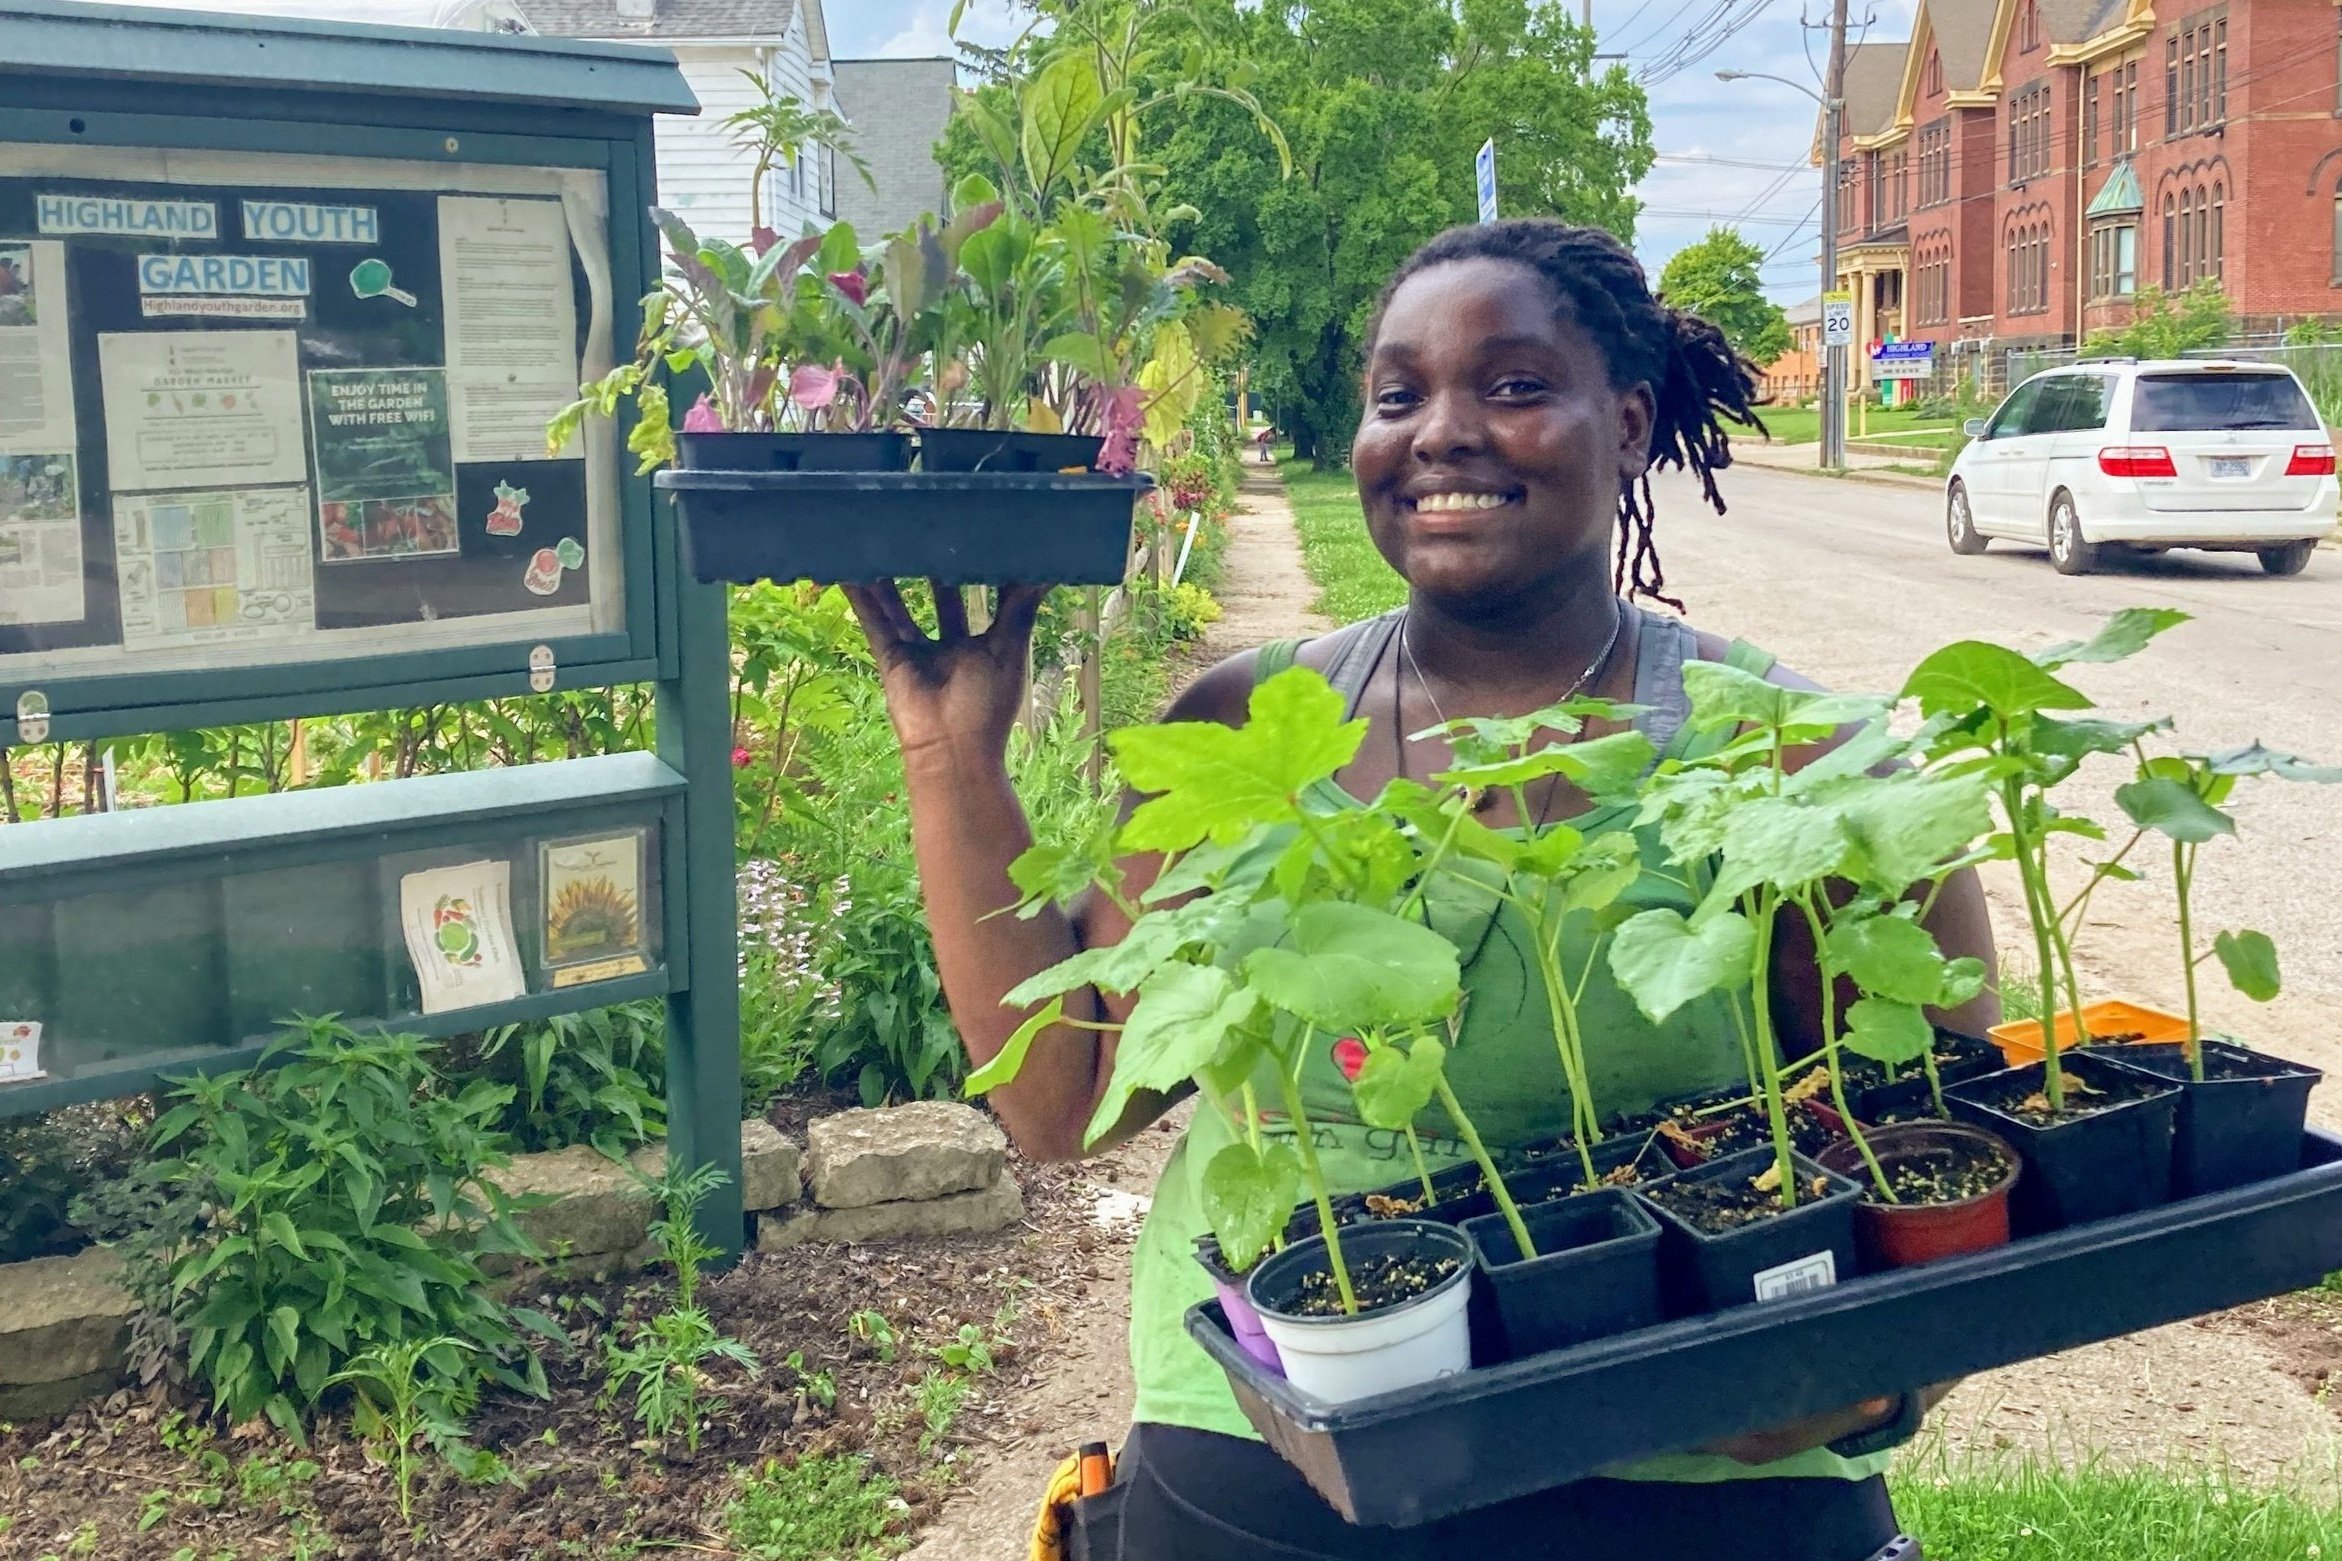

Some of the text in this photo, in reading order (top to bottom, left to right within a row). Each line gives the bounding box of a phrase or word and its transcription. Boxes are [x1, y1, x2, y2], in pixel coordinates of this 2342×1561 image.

[41, 200, 377, 241] HIGHLAND YOUTH
[142, 256, 307, 292] GARDEN
[143, 300, 301, 315] Highlandyouthgarden.org
[1827, 317, 1850, 332] 20
[1886, 343, 1927, 353] HIGHLAND
[331, 382, 428, 397] ENJOY TIME IN
[337, 397, 423, 411] THE GARDEN
[328, 410, 435, 426] WITH FREE WIFI
